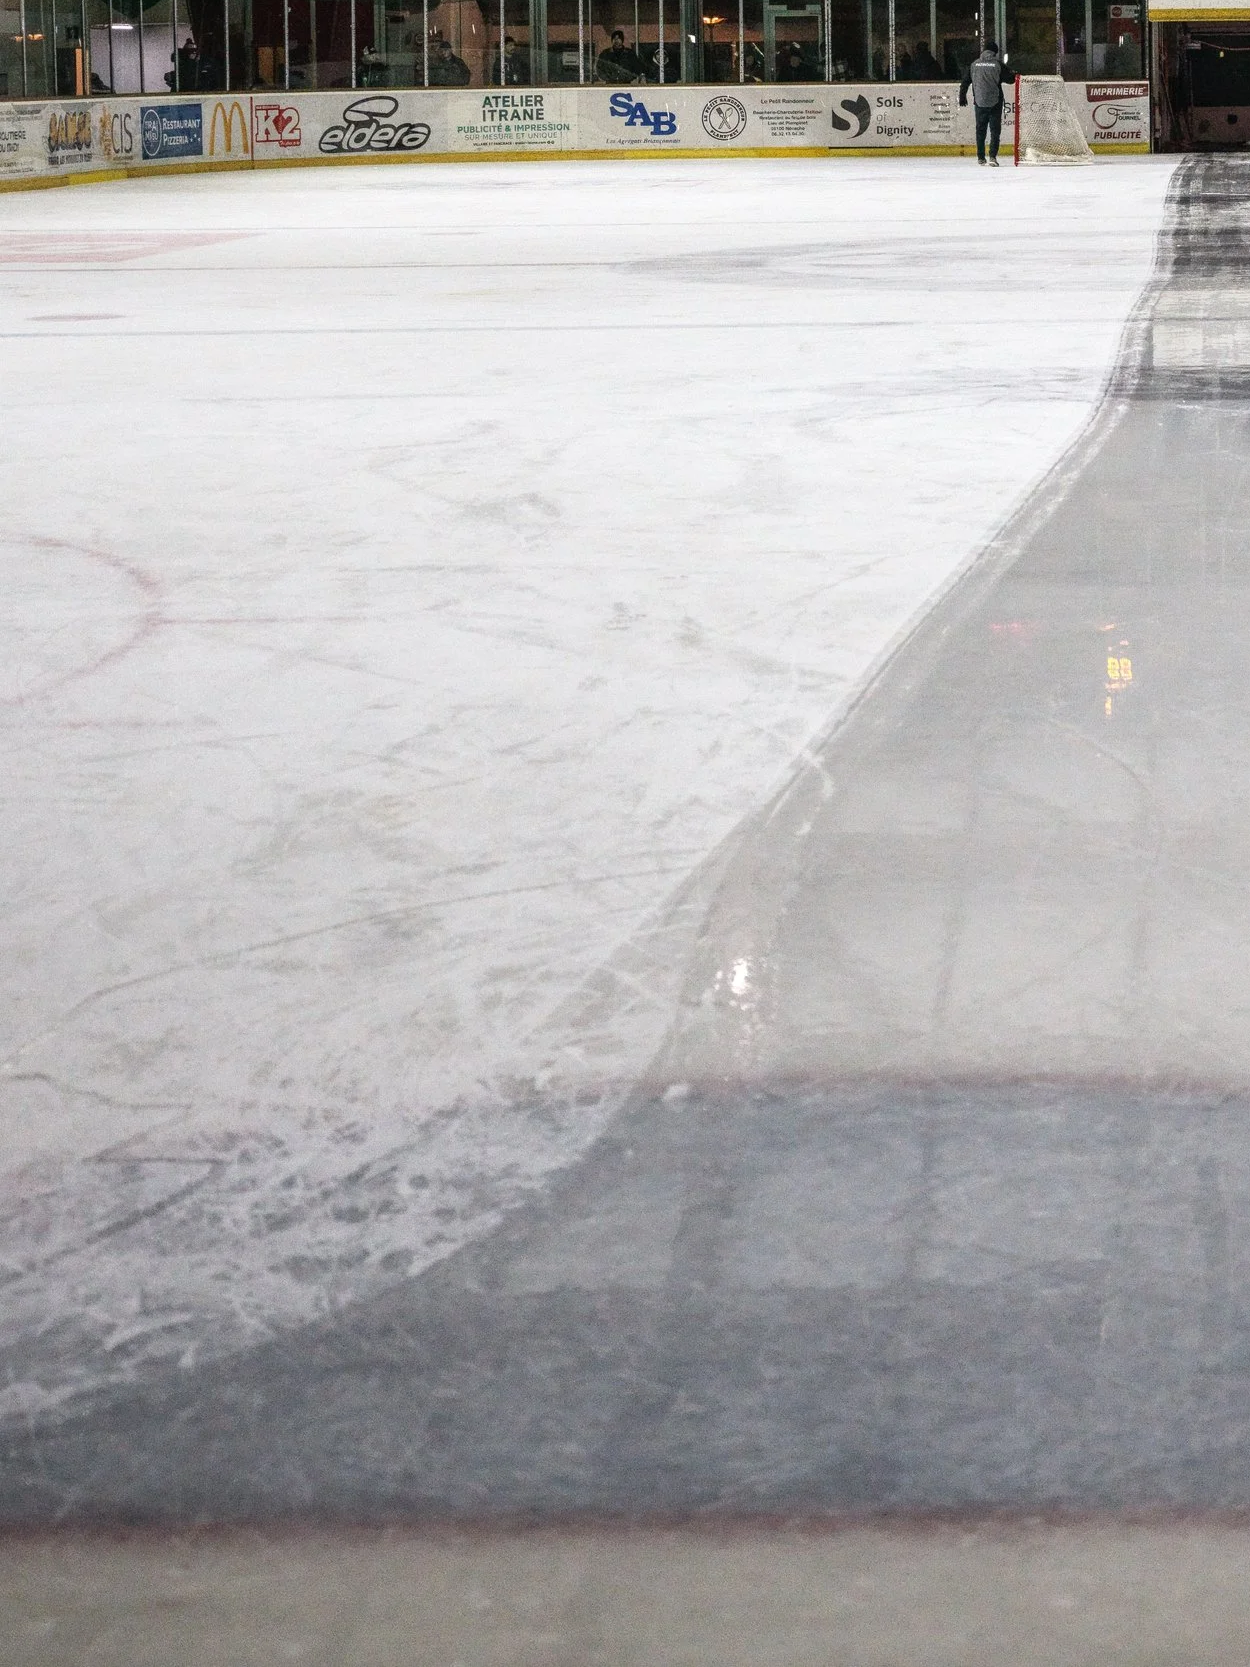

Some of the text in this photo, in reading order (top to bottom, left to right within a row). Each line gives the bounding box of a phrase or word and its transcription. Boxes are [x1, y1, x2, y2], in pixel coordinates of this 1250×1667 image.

[1090, 86, 1144, 96] IMPRIMERIE
[482, 95, 544, 109] ATELIER
[876, 96, 903, 108] Sols
[482, 108, 545, 122] ITRANE
[609, 93, 677, 136] SAB
[876, 112, 888, 122] of
[162, 118, 201, 130] RESTAURANT
[255, 107, 301, 142] K2
[457, 122, 570, 134] PUBLICITÉ & IMPRESSION
[111, 113, 133, 153] CIS
[464, 133, 480, 141] SUR
[482, 132, 514, 141] MESURE
[528, 131, 558, 139] UNIQUE
[876, 126, 914, 136] Dignity
[1094, 130, 1142, 139] PUBLICITÉ
[162, 134, 189, 146] PIZZERIA
